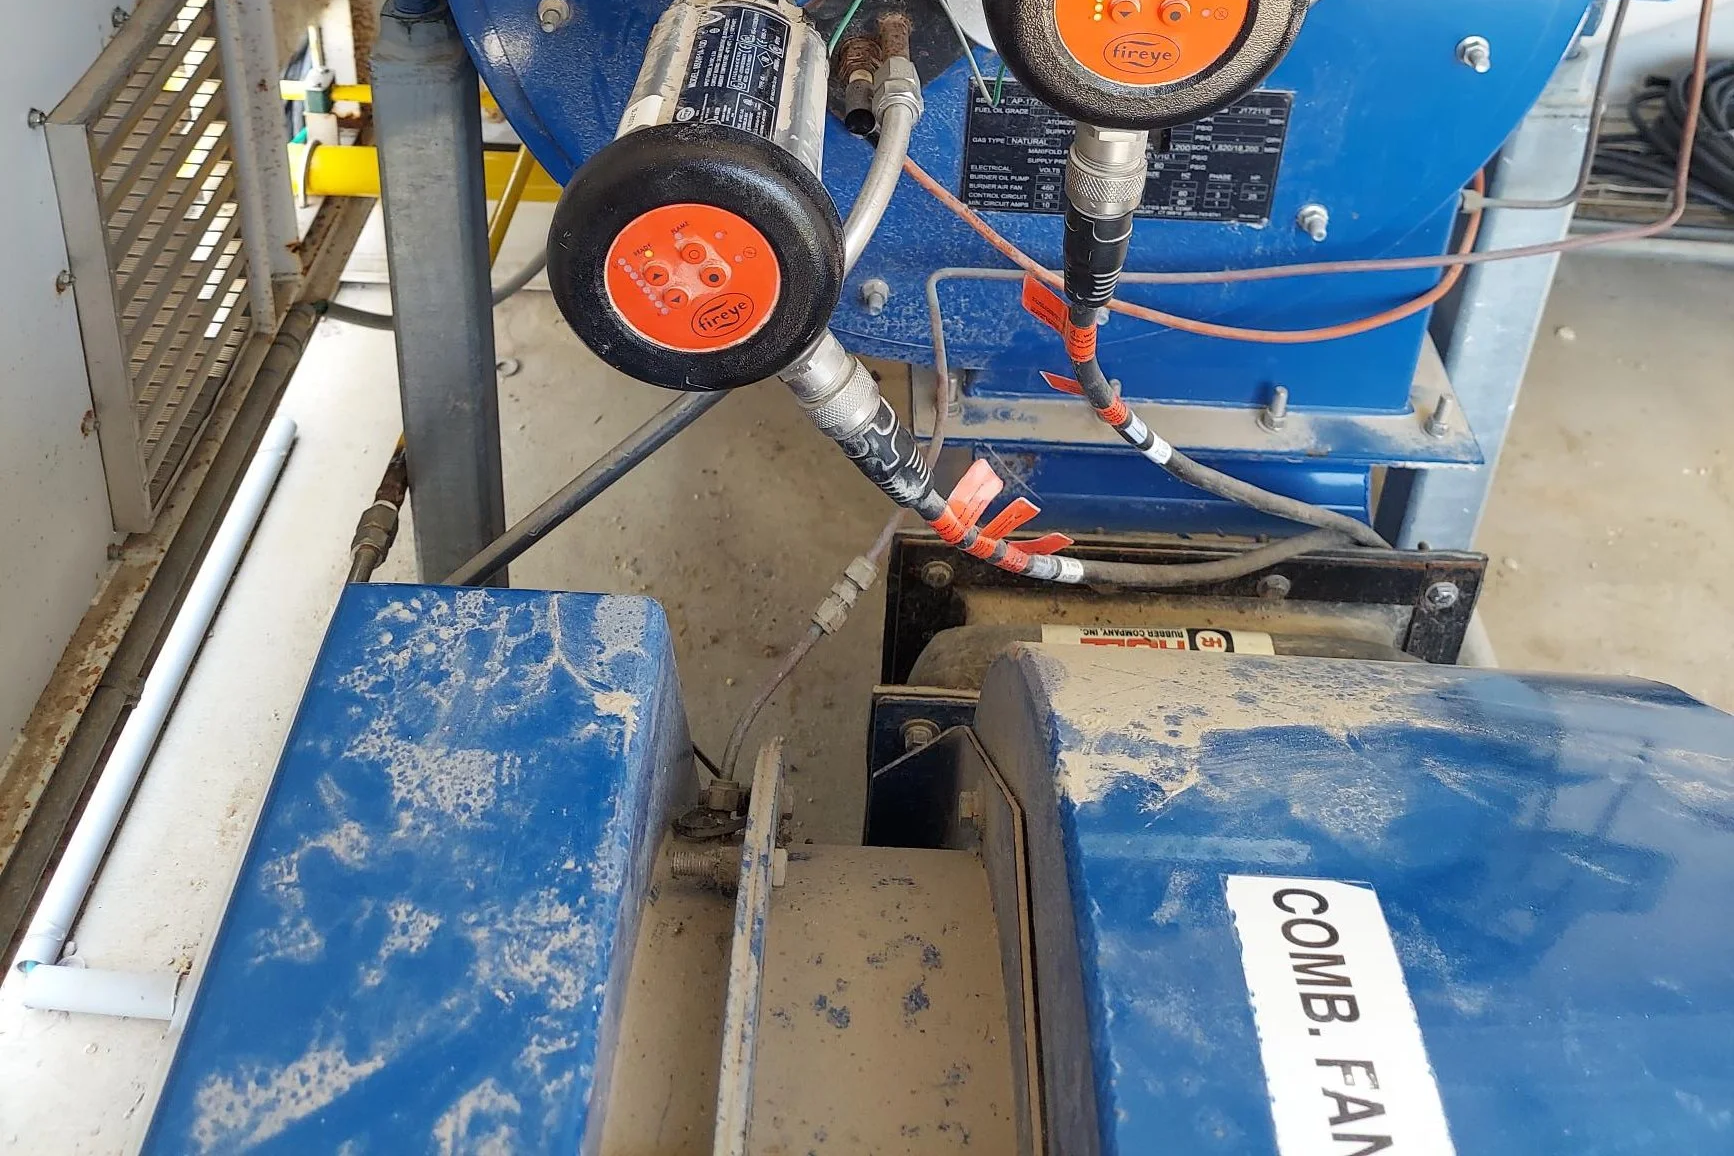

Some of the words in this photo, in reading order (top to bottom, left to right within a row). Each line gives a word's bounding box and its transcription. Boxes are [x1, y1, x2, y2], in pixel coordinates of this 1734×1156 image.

[1112, 42, 1172, 67] fireye
[1012, 138, 1048, 146] NATURAL
[699, 301, 747, 331] fireye
[1080, 628, 1099, 637] INC.
[1100, 628, 1145, 637] COMPANY,
[1148, 628, 1184, 639] RUBBER
[1201, 636, 1223, 648] HR
[1272, 888, 1360, 1036] COMB.
